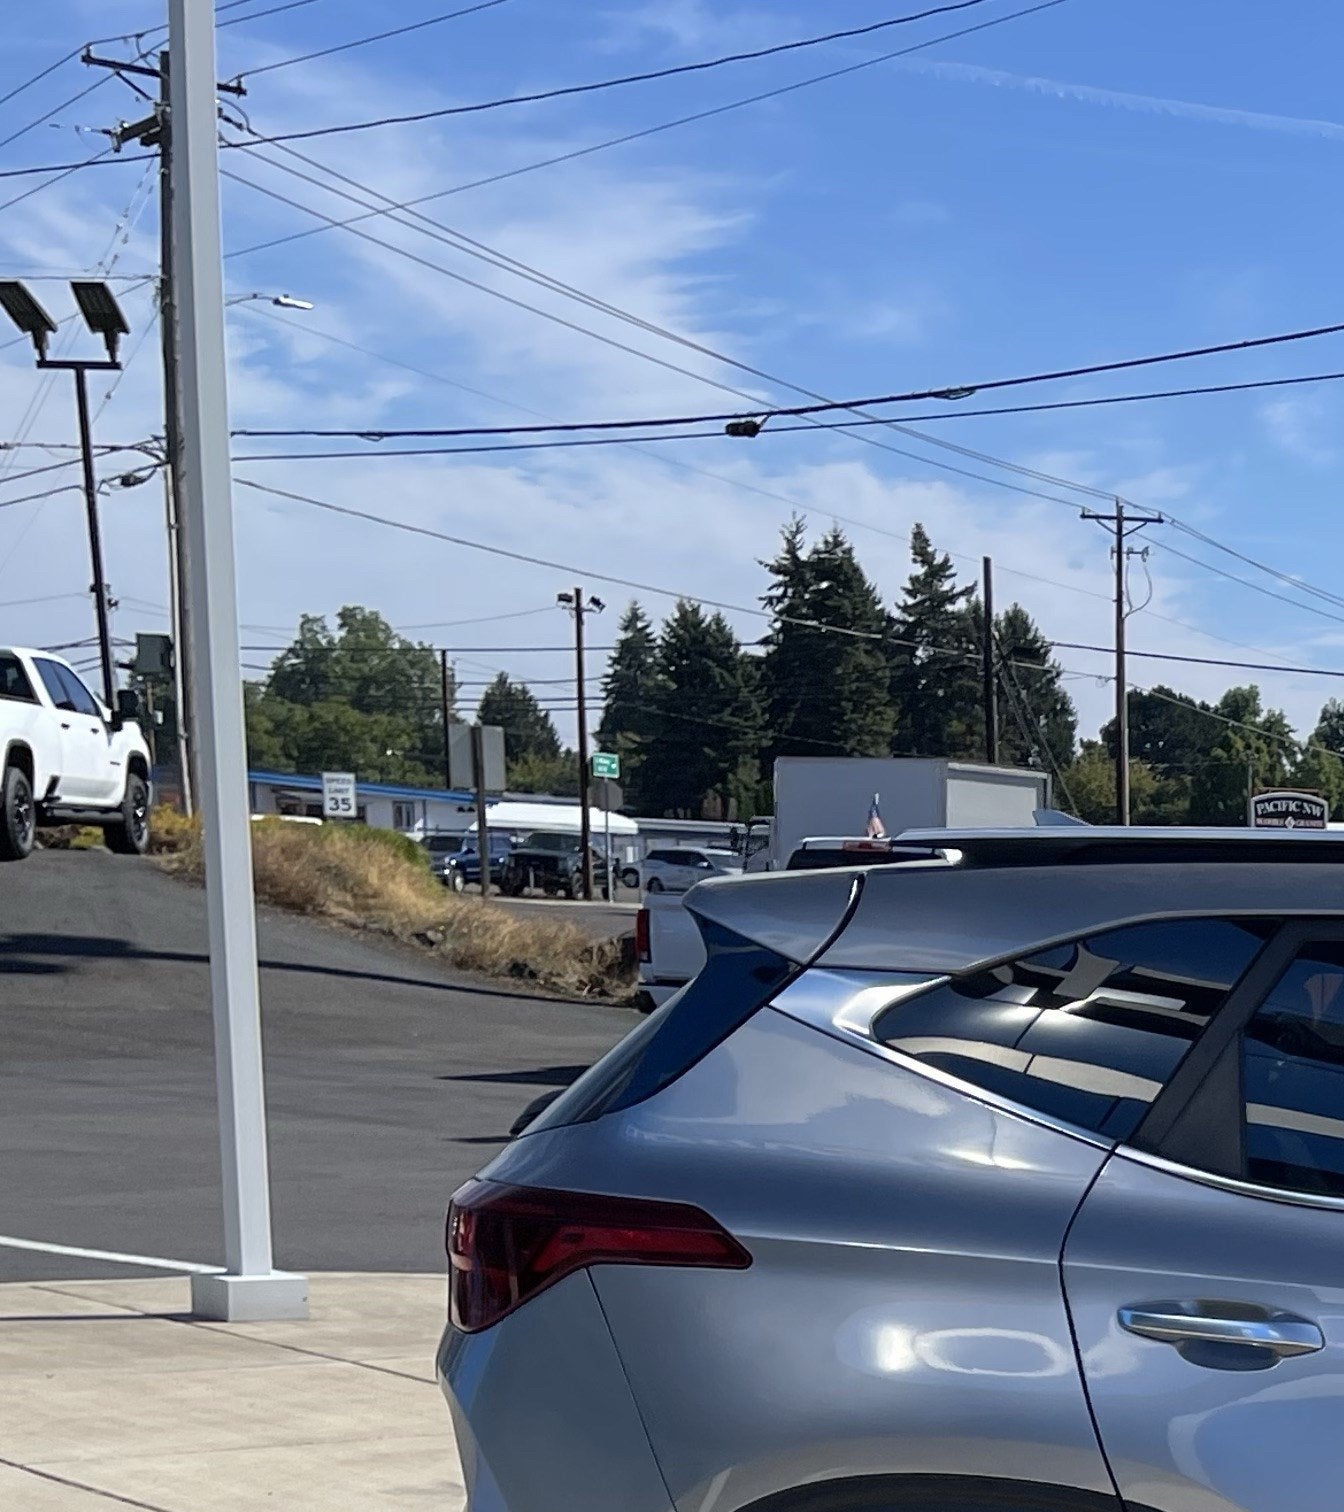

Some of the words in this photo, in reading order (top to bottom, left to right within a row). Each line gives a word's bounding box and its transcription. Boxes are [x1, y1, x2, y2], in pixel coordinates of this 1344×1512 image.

[329, 797, 351, 811] 35
[1256, 800, 1301, 815] PACIFIC
[1302, 802, 1323, 817] NW
